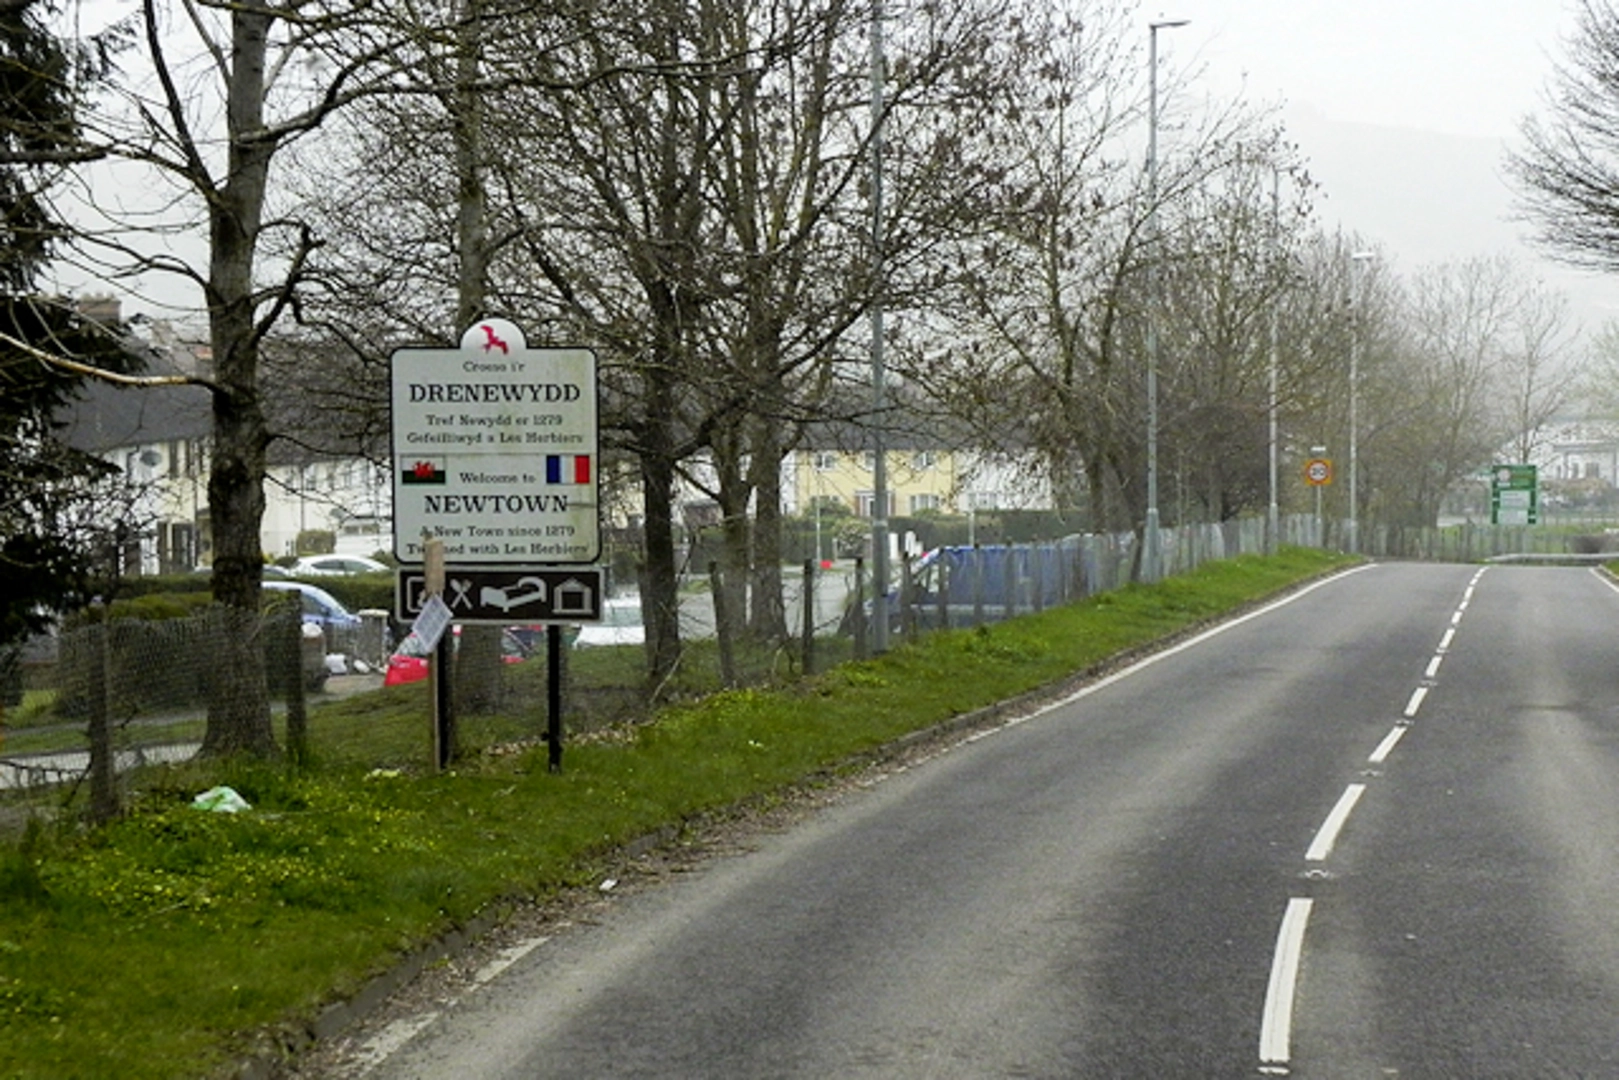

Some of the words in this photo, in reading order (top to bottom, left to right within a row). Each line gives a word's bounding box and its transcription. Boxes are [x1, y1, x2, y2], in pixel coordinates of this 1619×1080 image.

[462, 361, 506, 372] Croeso
[409, 384, 581, 402] DRENEWYDD
[425, 415, 454, 426] Tref
[459, 415, 512, 428] Newydd
[516, 417, 528, 426] er
[533, 415, 562, 426] 1279
[500, 433, 522, 443] Les
[526, 433, 583, 443] Herbiers
[459, 473, 518, 484] Welcome
[522, 473, 536, 484] to
[424, 495, 568, 513] NEWTOWN
[420, 526, 431, 537] A
[434, 526, 462, 537] New
[467, 526, 504, 537] Town
[508, 526, 542, 537] since
[545, 526, 575, 537] 1279
[469, 544, 499, 555] with
[505, 544, 527, 555] Les
[531, 544, 587, 555] Herbiers
